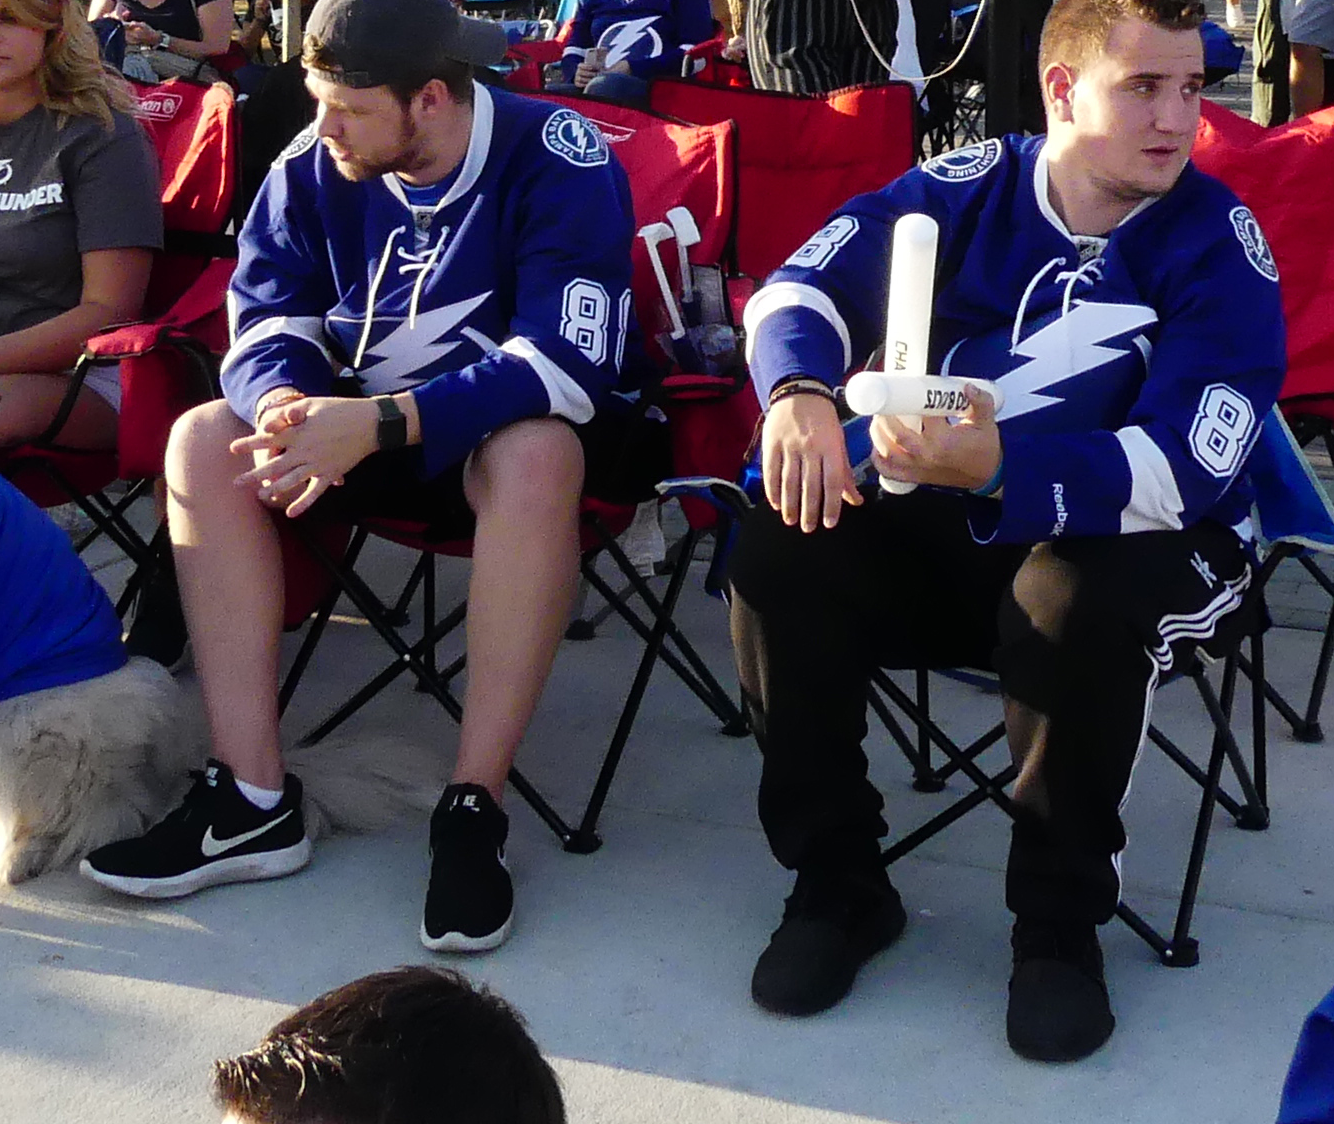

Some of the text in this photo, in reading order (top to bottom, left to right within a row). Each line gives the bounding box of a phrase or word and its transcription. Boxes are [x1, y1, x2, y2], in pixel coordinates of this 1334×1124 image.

[947, 144, 996, 178] LIGHTNING
[781, 214, 860, 271] 8
[559, 277, 632, 375] 8
[1188, 382, 1256, 478] 8
[1050, 483, 1068, 537] Reebok
